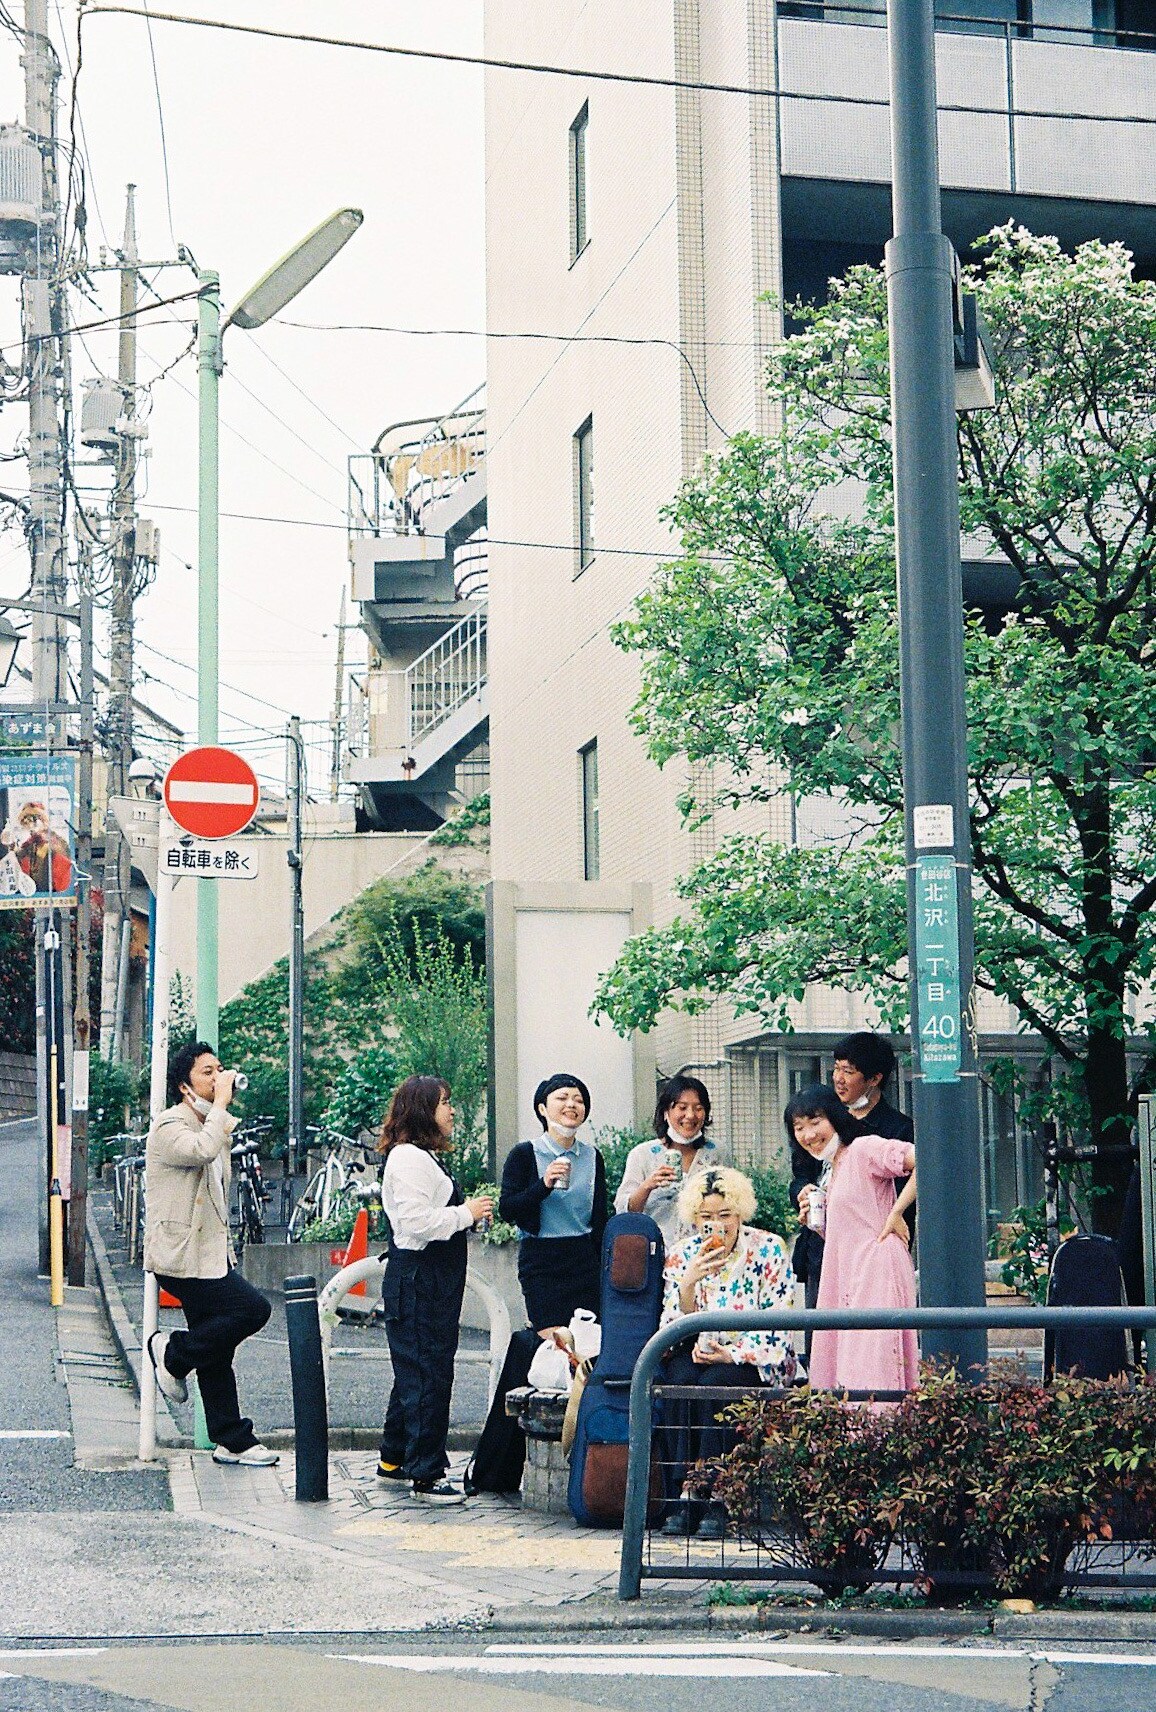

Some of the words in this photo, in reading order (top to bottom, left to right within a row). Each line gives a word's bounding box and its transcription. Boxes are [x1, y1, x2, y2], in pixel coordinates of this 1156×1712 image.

[168, 849, 250, 870] 自転車を除く
[922, 1015, 955, 1039] 40
